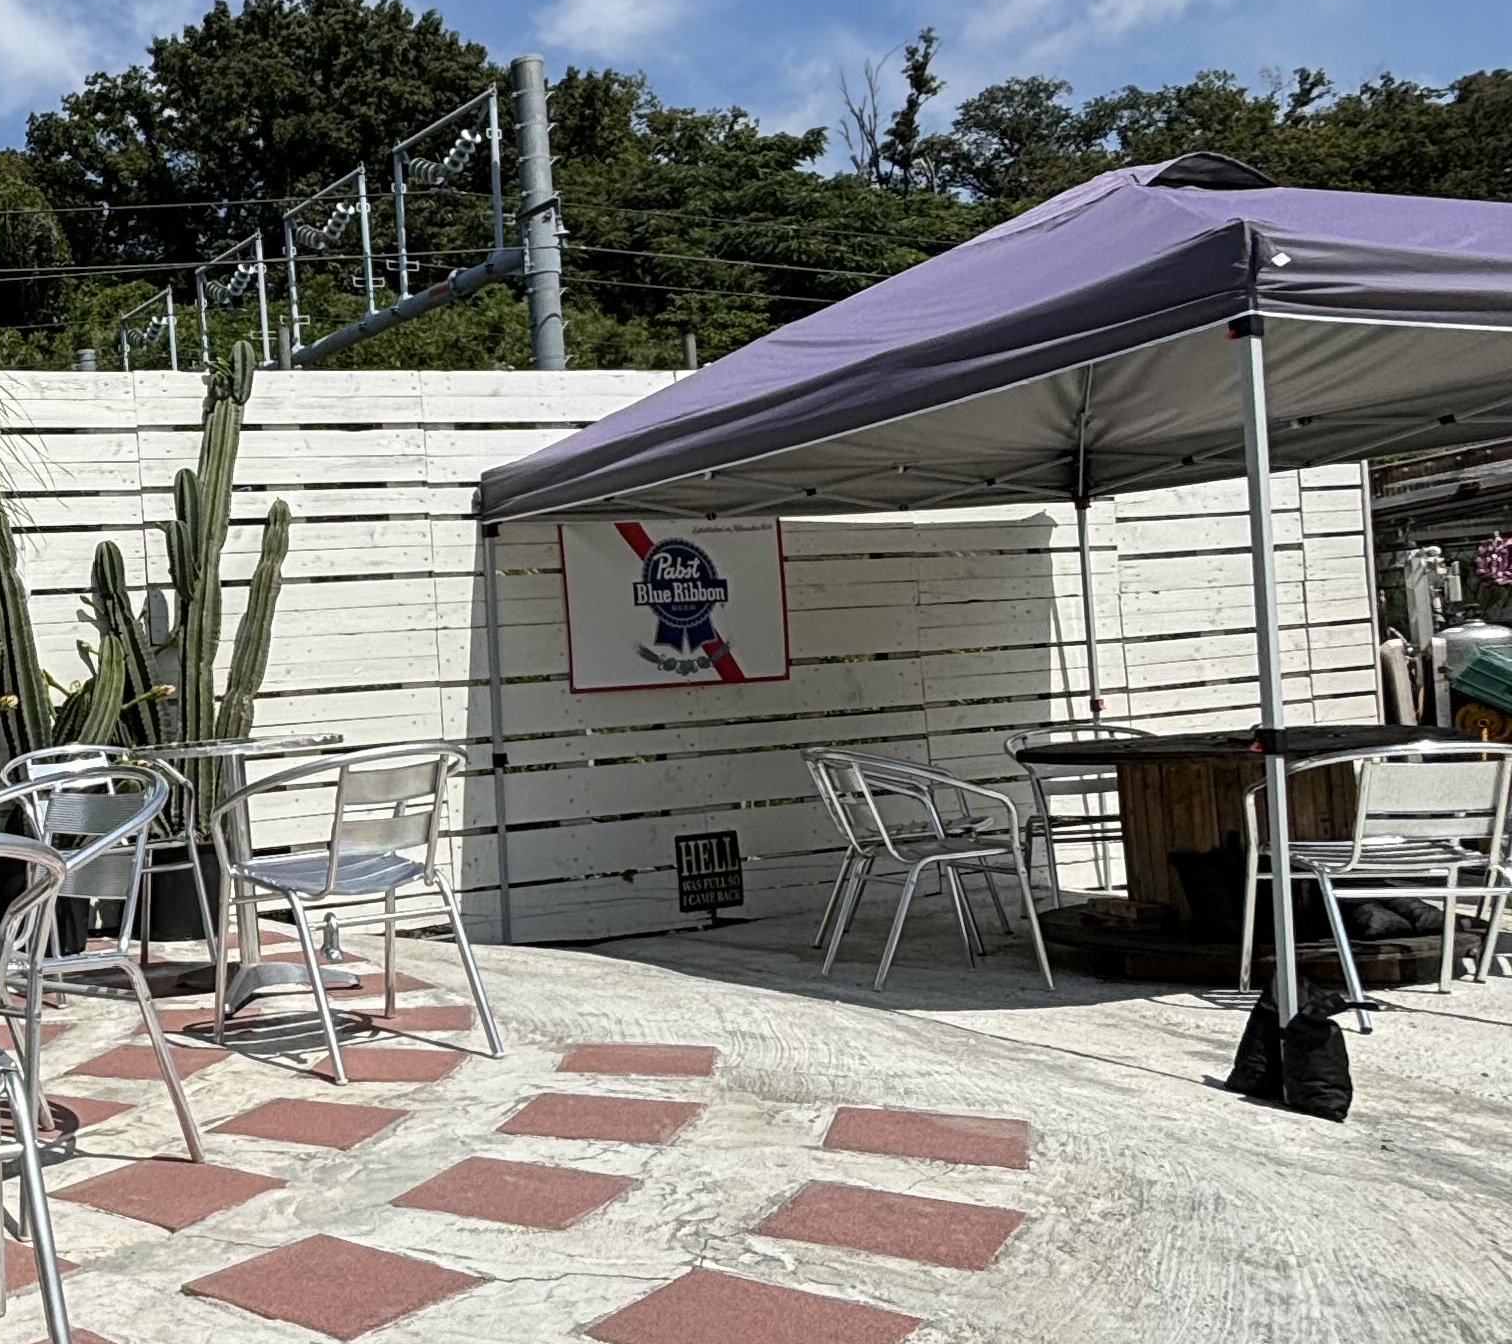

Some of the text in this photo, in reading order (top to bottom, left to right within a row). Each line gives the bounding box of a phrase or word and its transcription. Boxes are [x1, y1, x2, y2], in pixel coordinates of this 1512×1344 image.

[652, 552, 701, 580] Pabst
[635, 581, 726, 604] Blue Ribbon
[678, 836, 739, 876] HELL
[682, 874, 741, 892] WAS FULL SO
[683, 889, 741, 906] I CAME BACK
